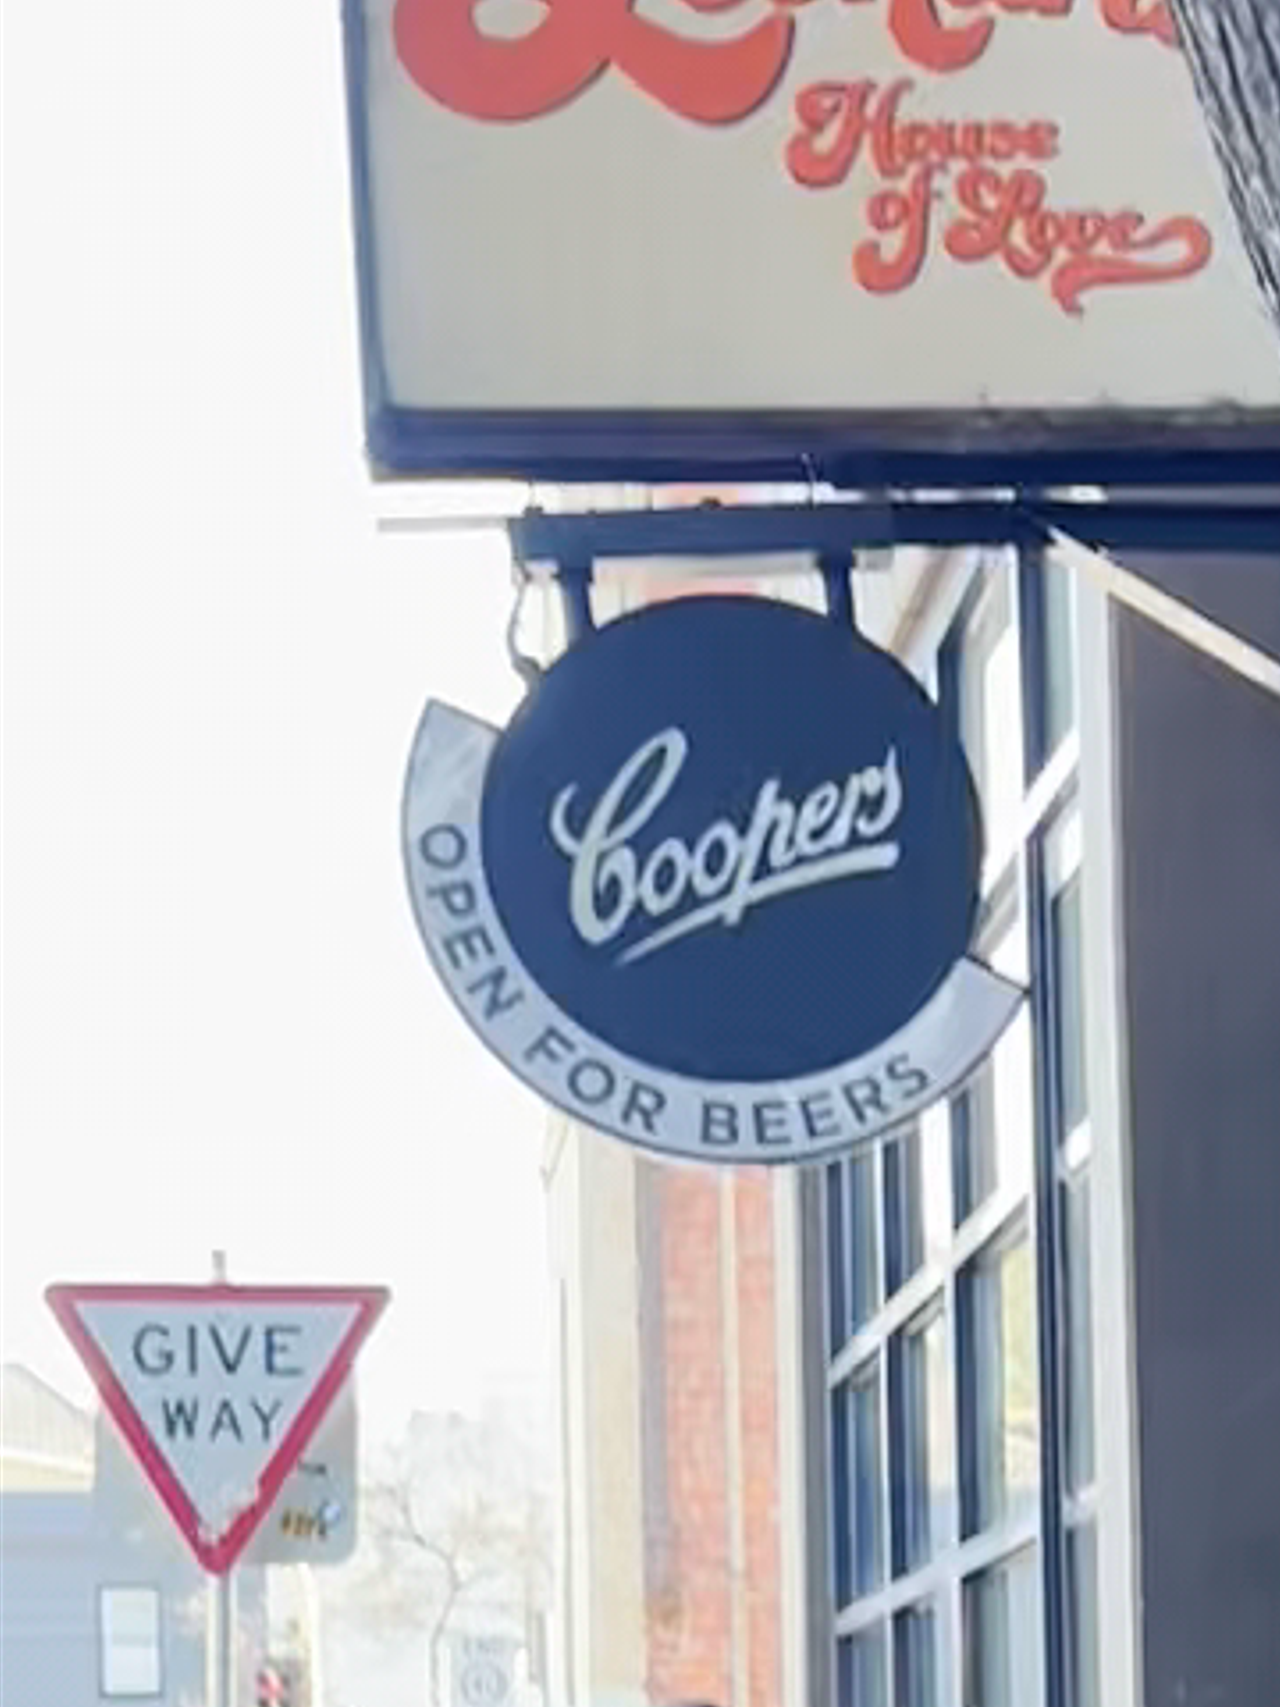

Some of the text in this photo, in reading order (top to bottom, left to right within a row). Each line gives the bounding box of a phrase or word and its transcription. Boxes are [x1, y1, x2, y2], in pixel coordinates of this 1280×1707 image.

[786, 77, 1060, 189] House
[852, 159, 1213, 319] of Love
[551, 726, 904, 965] Coopers
[419, 823, 931, 1147] OPEN FOR BEERS
[132, 1324, 304, 1376] GIVE
[161, 1399, 284, 1442] WAY
